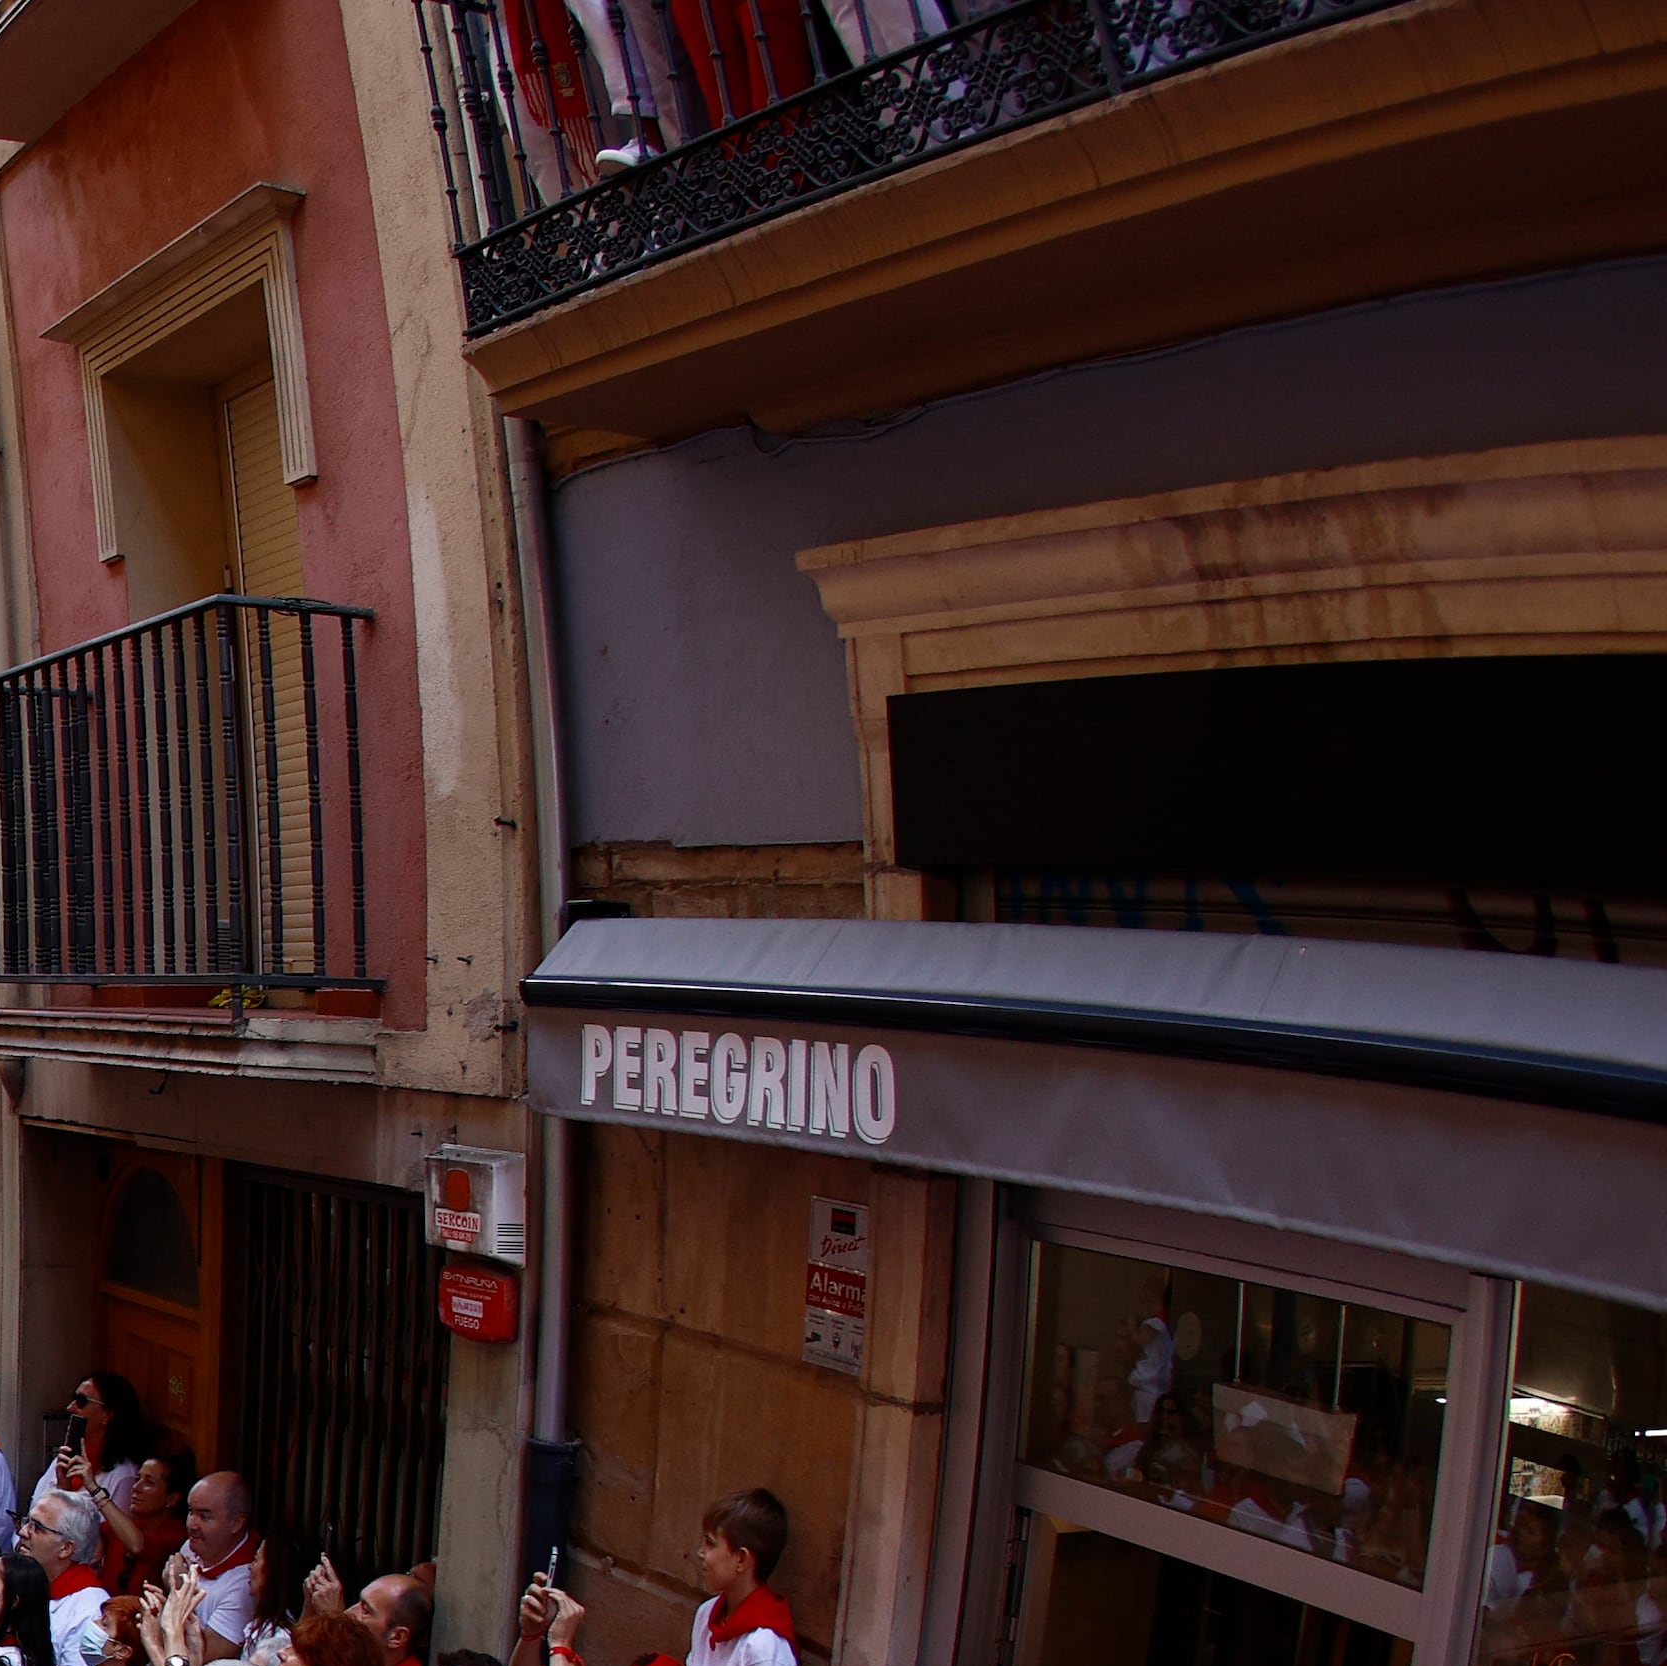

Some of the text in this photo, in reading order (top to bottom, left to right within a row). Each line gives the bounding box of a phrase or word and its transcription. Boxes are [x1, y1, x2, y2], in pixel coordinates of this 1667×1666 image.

[580, 1024, 896, 1145] PEREGRINO
[437, 1212, 479, 1231] SERCOIN
[820, 1234, 867, 1258] Direct
[454, 1314, 480, 1330] FUEGO
